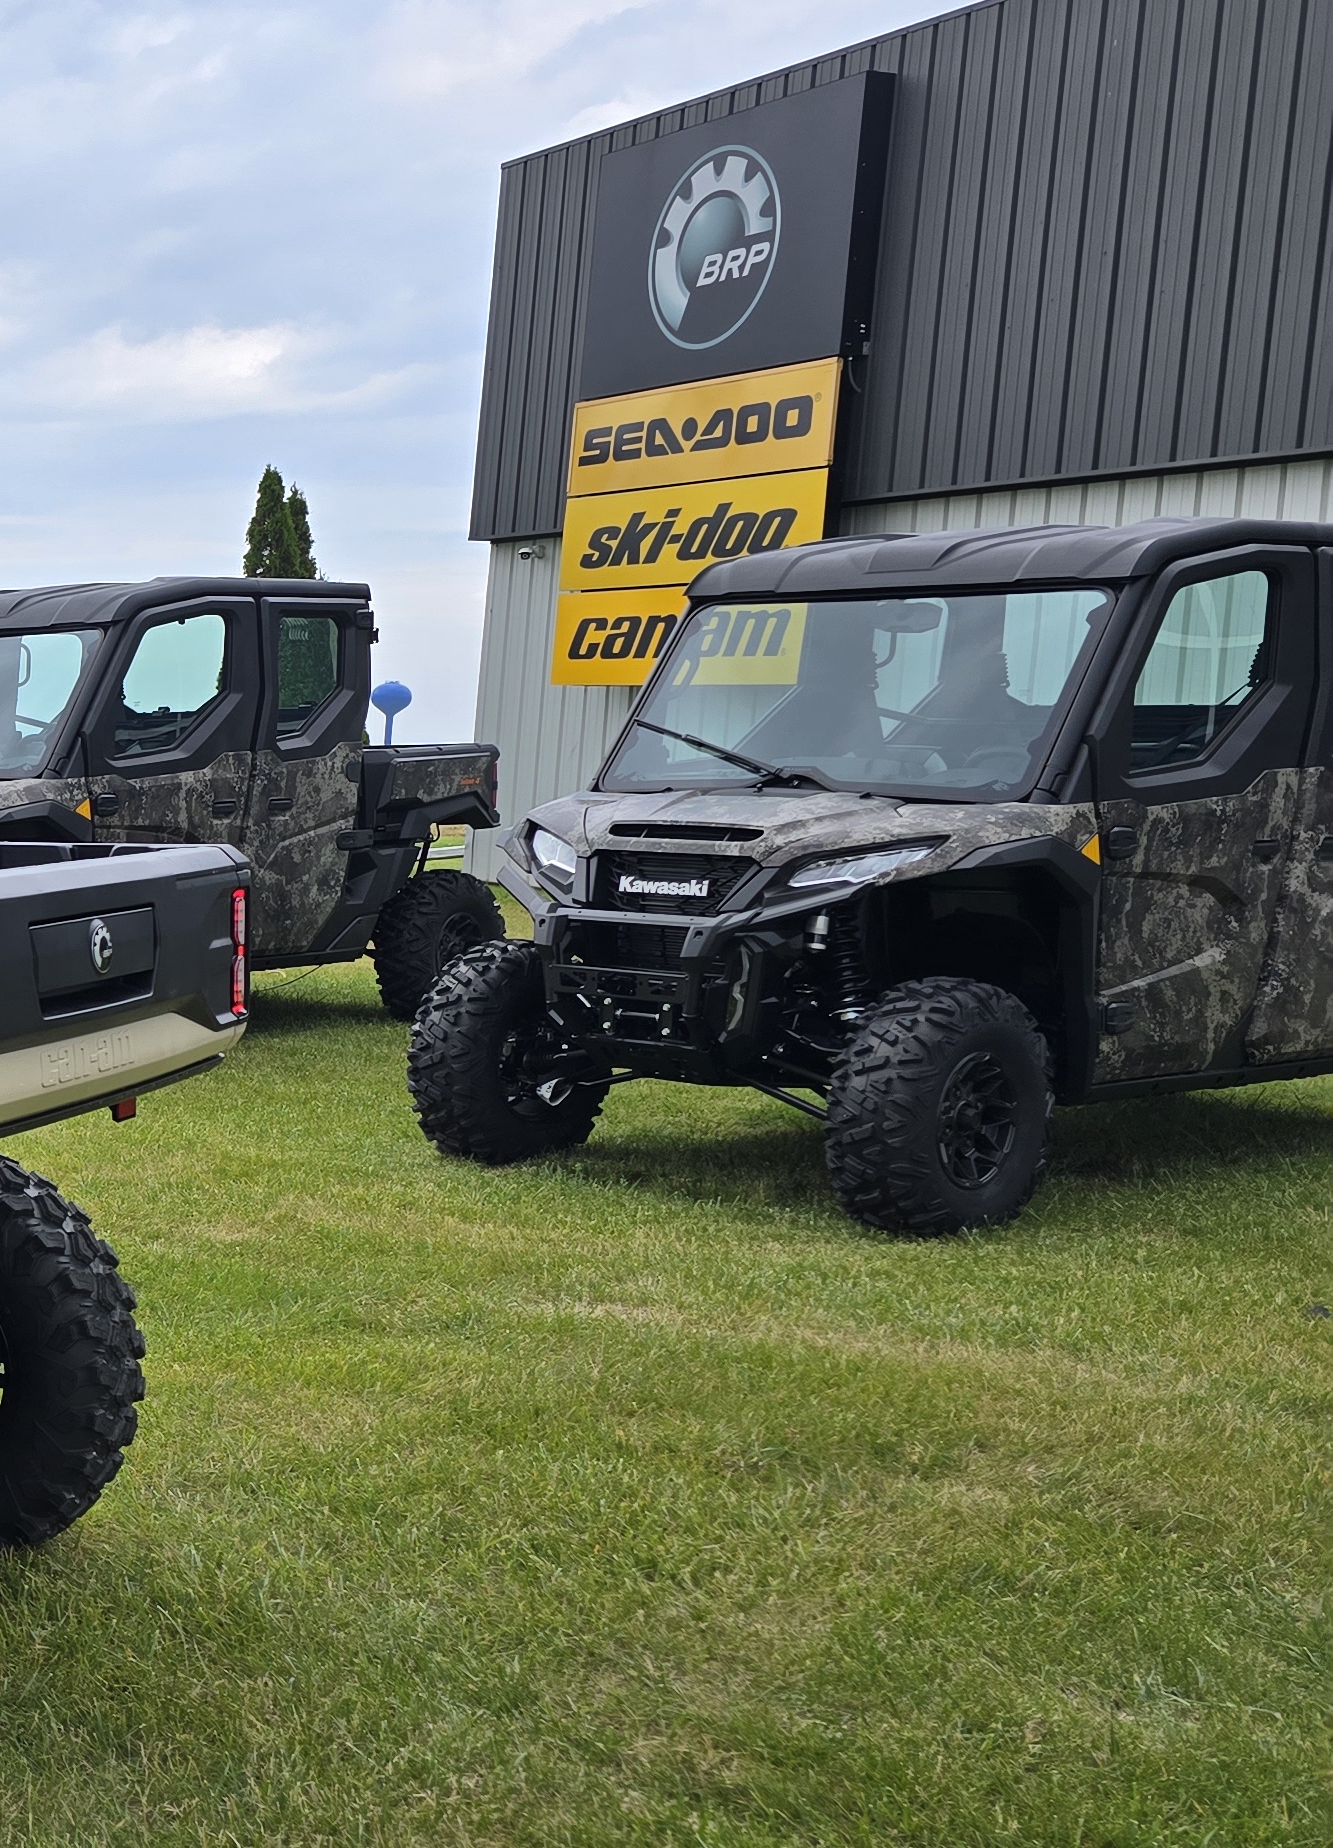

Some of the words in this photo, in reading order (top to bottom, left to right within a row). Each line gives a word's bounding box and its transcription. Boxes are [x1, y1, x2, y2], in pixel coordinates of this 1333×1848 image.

[695, 241, 771, 288] BRP
[579, 501, 798, 569] ski-doo
[618, 875, 710, 897] Kawasaki
[39, 1028, 136, 1088] can-am
